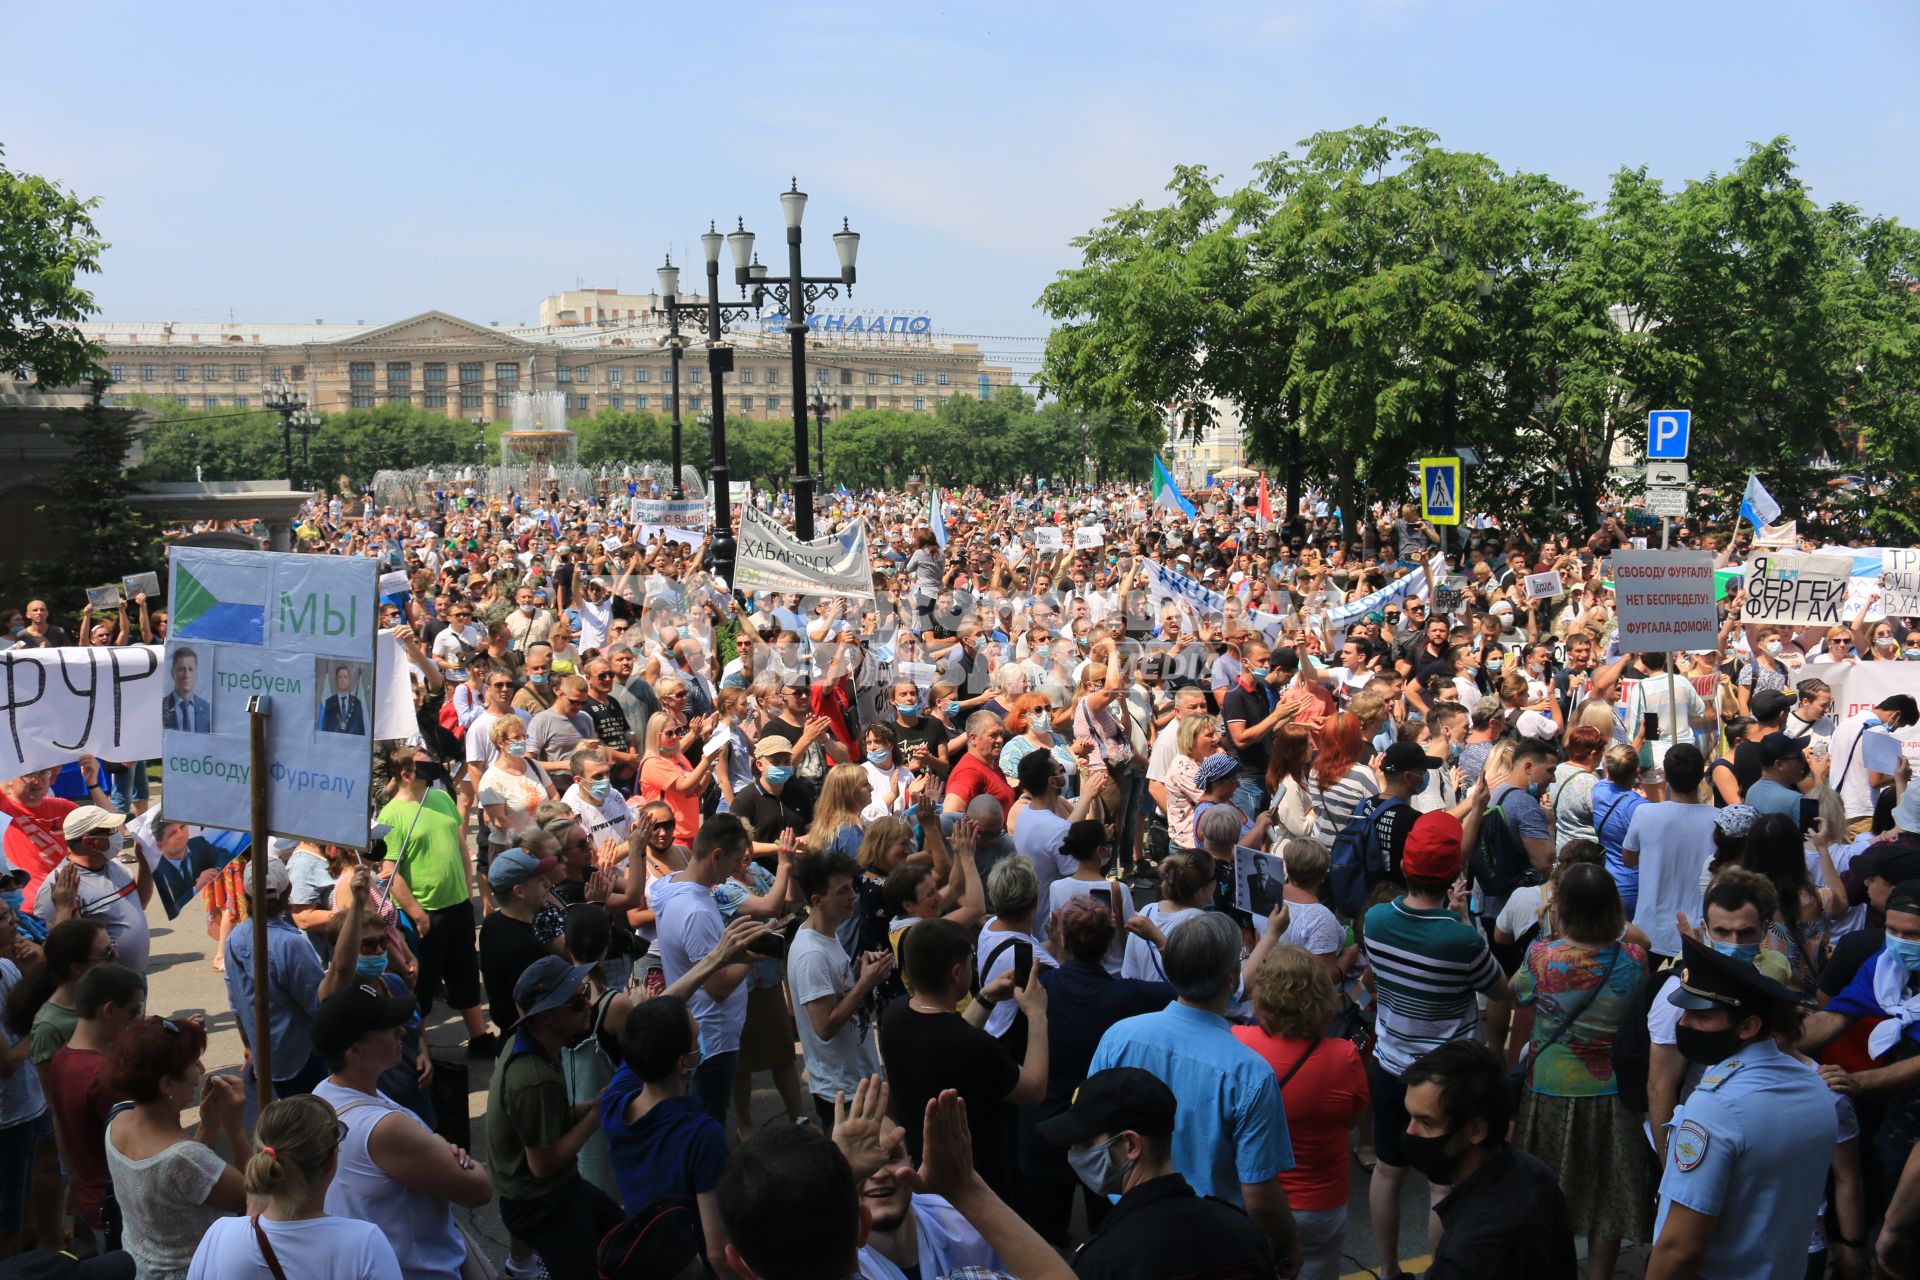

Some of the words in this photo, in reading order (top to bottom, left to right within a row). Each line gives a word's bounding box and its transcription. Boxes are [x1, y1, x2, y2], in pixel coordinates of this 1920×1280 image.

[805, 315, 932, 334] КНААПО
[1656, 416, 1679, 451] P
[674, 514, 704, 523] Вами!
[742, 538, 837, 573] ХАБАРОВСК
[1617, 566, 1665, 580] СВОБОДУ
[1667, 566, 1713, 578] ФУРГАЛУ!
[1626, 594, 1645, 606] НЕТ
[1647, 593, 1709, 607] БЕСПРЕДЕЛУ!
[1748, 577, 1847, 602] СЕРГЕЙ
[279, 590, 358, 638] МЫ
[1745, 596, 1840, 622] ФУРГАЛ
[1626, 620, 1672, 634] ФУРГАЛА
[1673, 618, 1713, 634] ДОМОЙ!
[217, 669, 301, 696] требуем
[170, 755, 250, 785] свободу
